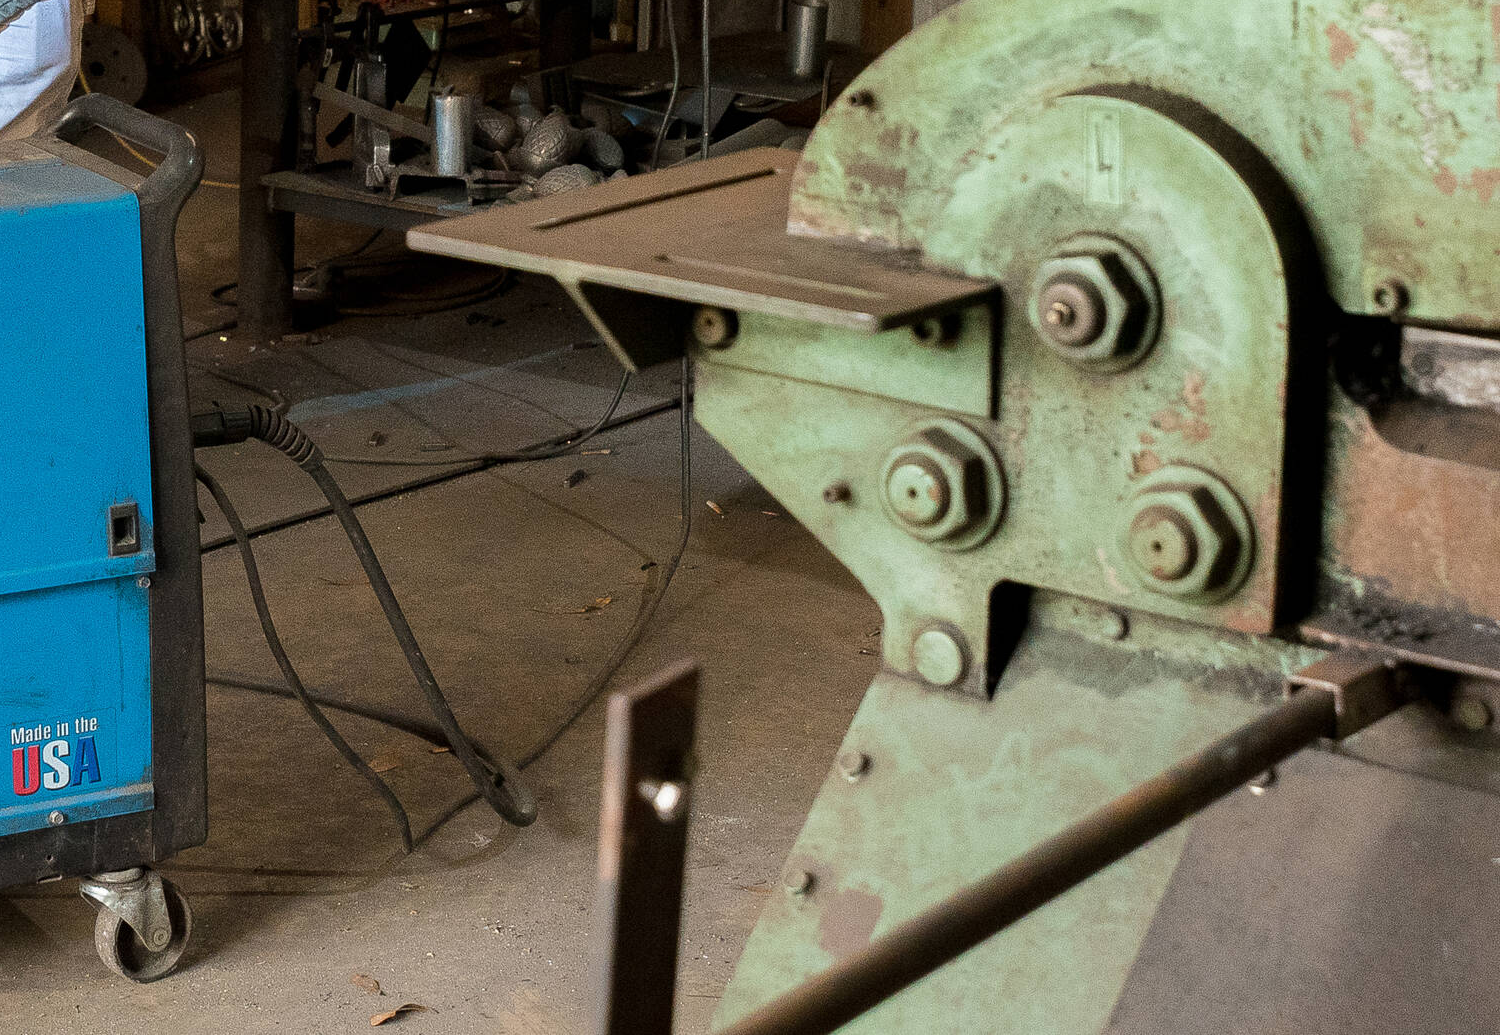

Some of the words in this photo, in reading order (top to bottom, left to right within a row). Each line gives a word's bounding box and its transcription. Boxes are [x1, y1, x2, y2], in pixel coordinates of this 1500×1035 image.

[10, 723, 51, 745] Made
[56, 720, 69, 737] in
[75, 716, 98, 734] the
[12, 735, 102, 796] USA
